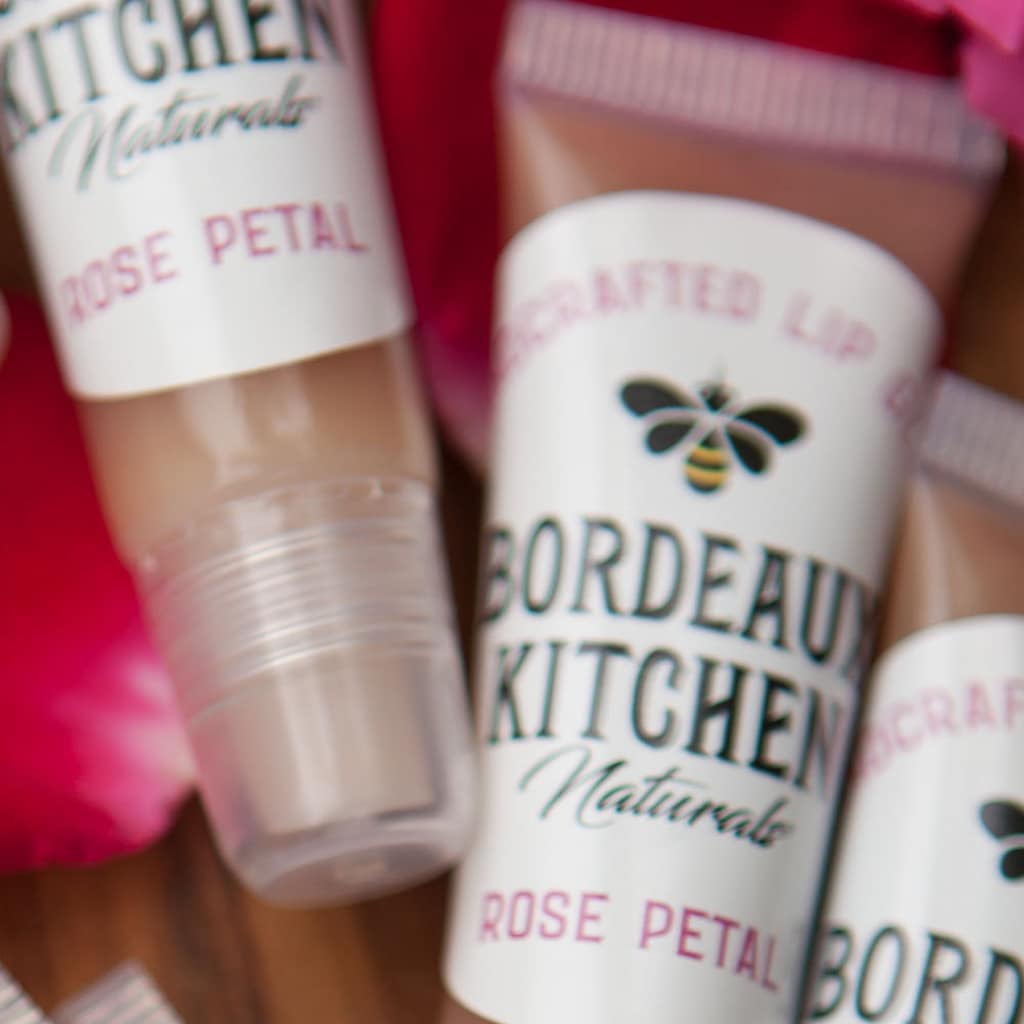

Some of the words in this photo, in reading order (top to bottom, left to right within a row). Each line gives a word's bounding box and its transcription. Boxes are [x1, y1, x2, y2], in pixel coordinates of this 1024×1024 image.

[58, 230, 180, 325] ROSE
[203, 201, 370, 268] PETAL
[480, 891, 610, 944] ROSE
[637, 900, 783, 993] PETAL
